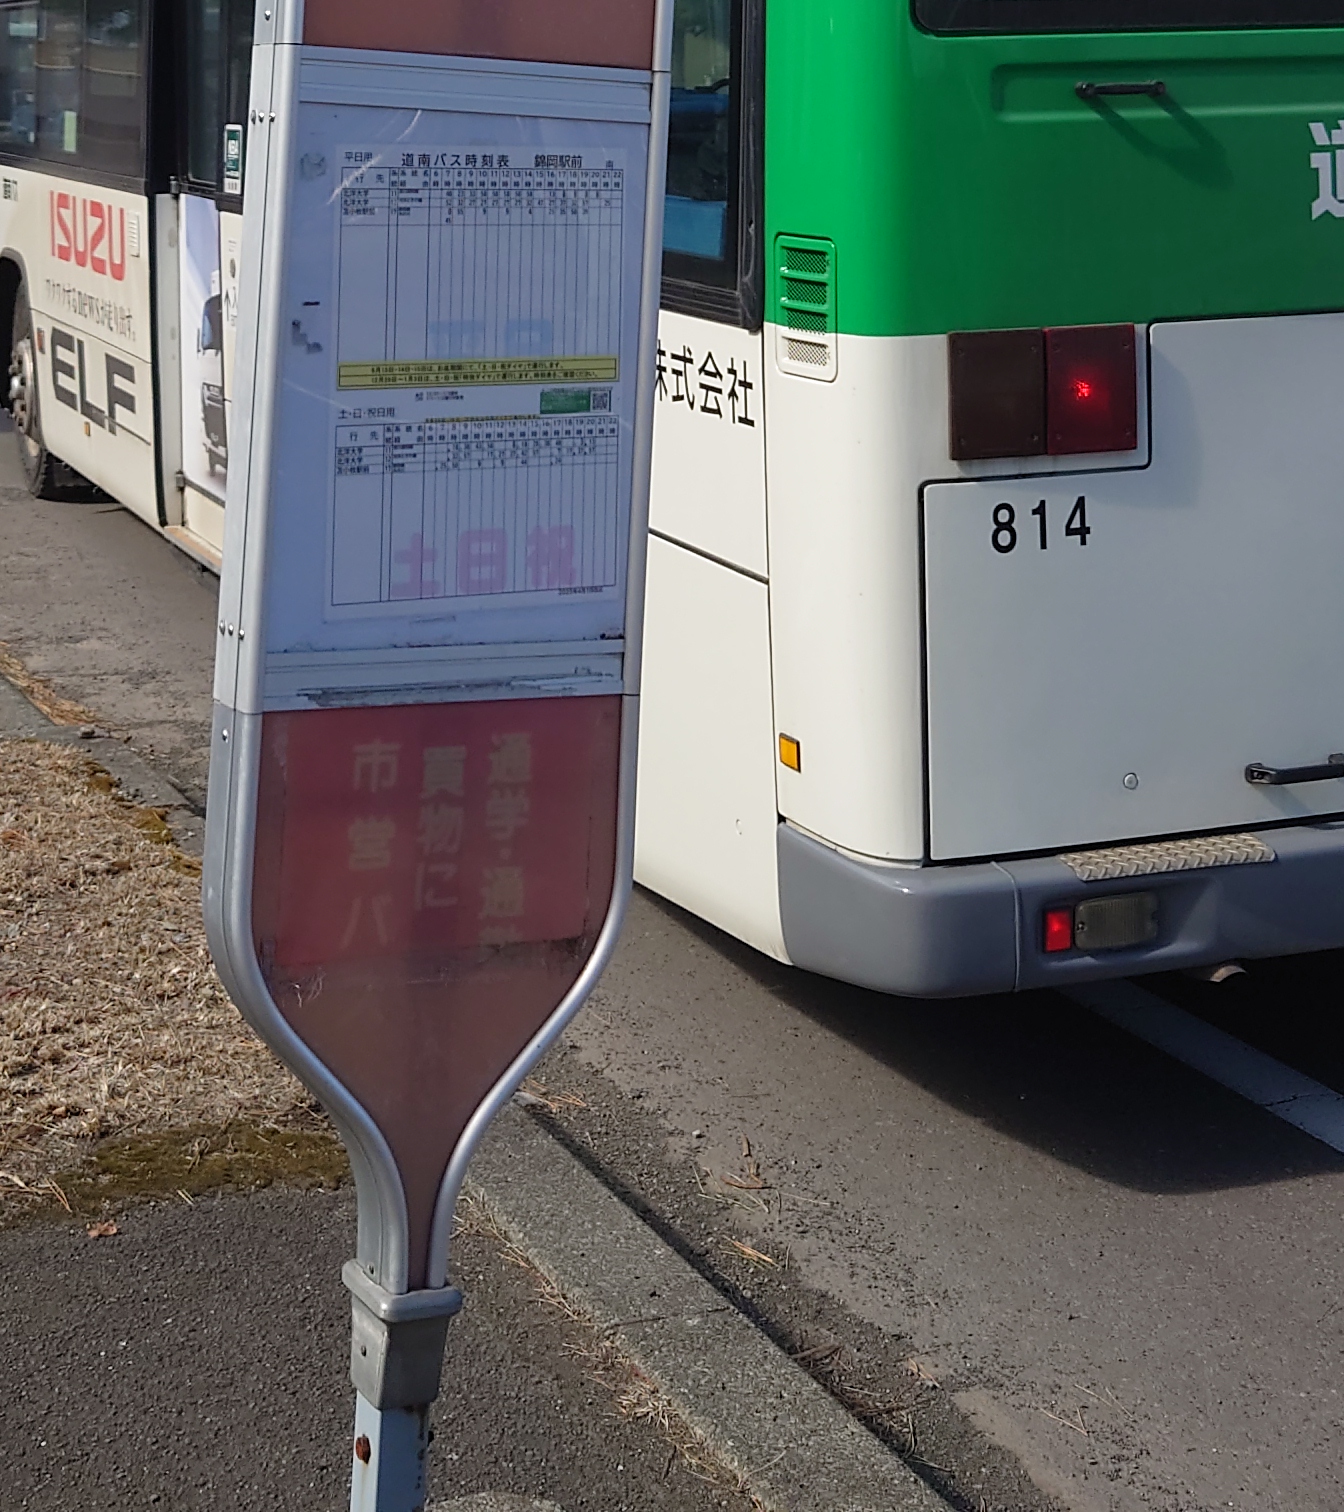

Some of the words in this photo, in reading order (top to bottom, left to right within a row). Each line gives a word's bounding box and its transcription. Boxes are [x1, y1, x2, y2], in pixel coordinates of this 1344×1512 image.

[401, 153, 509, 168] 道南バス時刻表
[534, 154, 583, 169] 錦岡駅前
[50, 190, 125, 282] ISUZU
[51, 326, 136, 436] ELF
[990, 495, 1091, 554] 814
[390, 524, 576, 598] 土日祝
